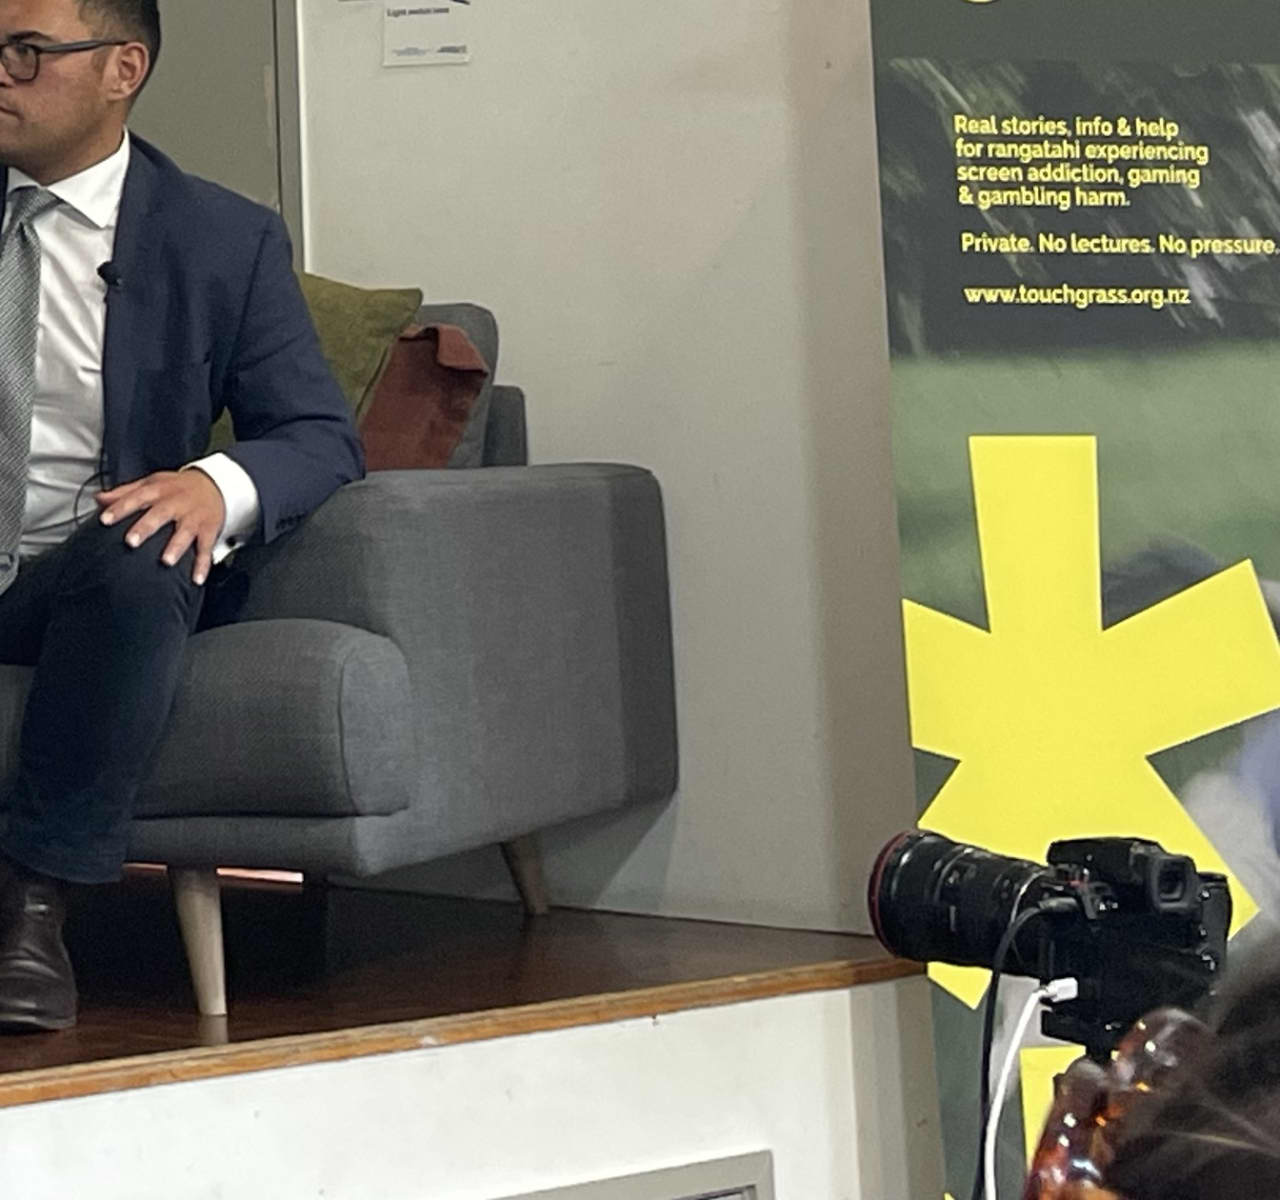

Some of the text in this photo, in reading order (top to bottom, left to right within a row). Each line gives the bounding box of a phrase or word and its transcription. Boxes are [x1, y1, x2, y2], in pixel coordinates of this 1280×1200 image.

[953, 114, 1179, 140] Real stories, info & help
[955, 137, 1209, 166] for rangatahi experiencing
[956, 163, 1201, 188] screen addiction, gaming
[958, 185, 1131, 210] & gambling harm.
[961, 232, 1280, 258] Private. No lectures. No pressure.
[963, 284, 1191, 309] www.touchgrass.org.nz
